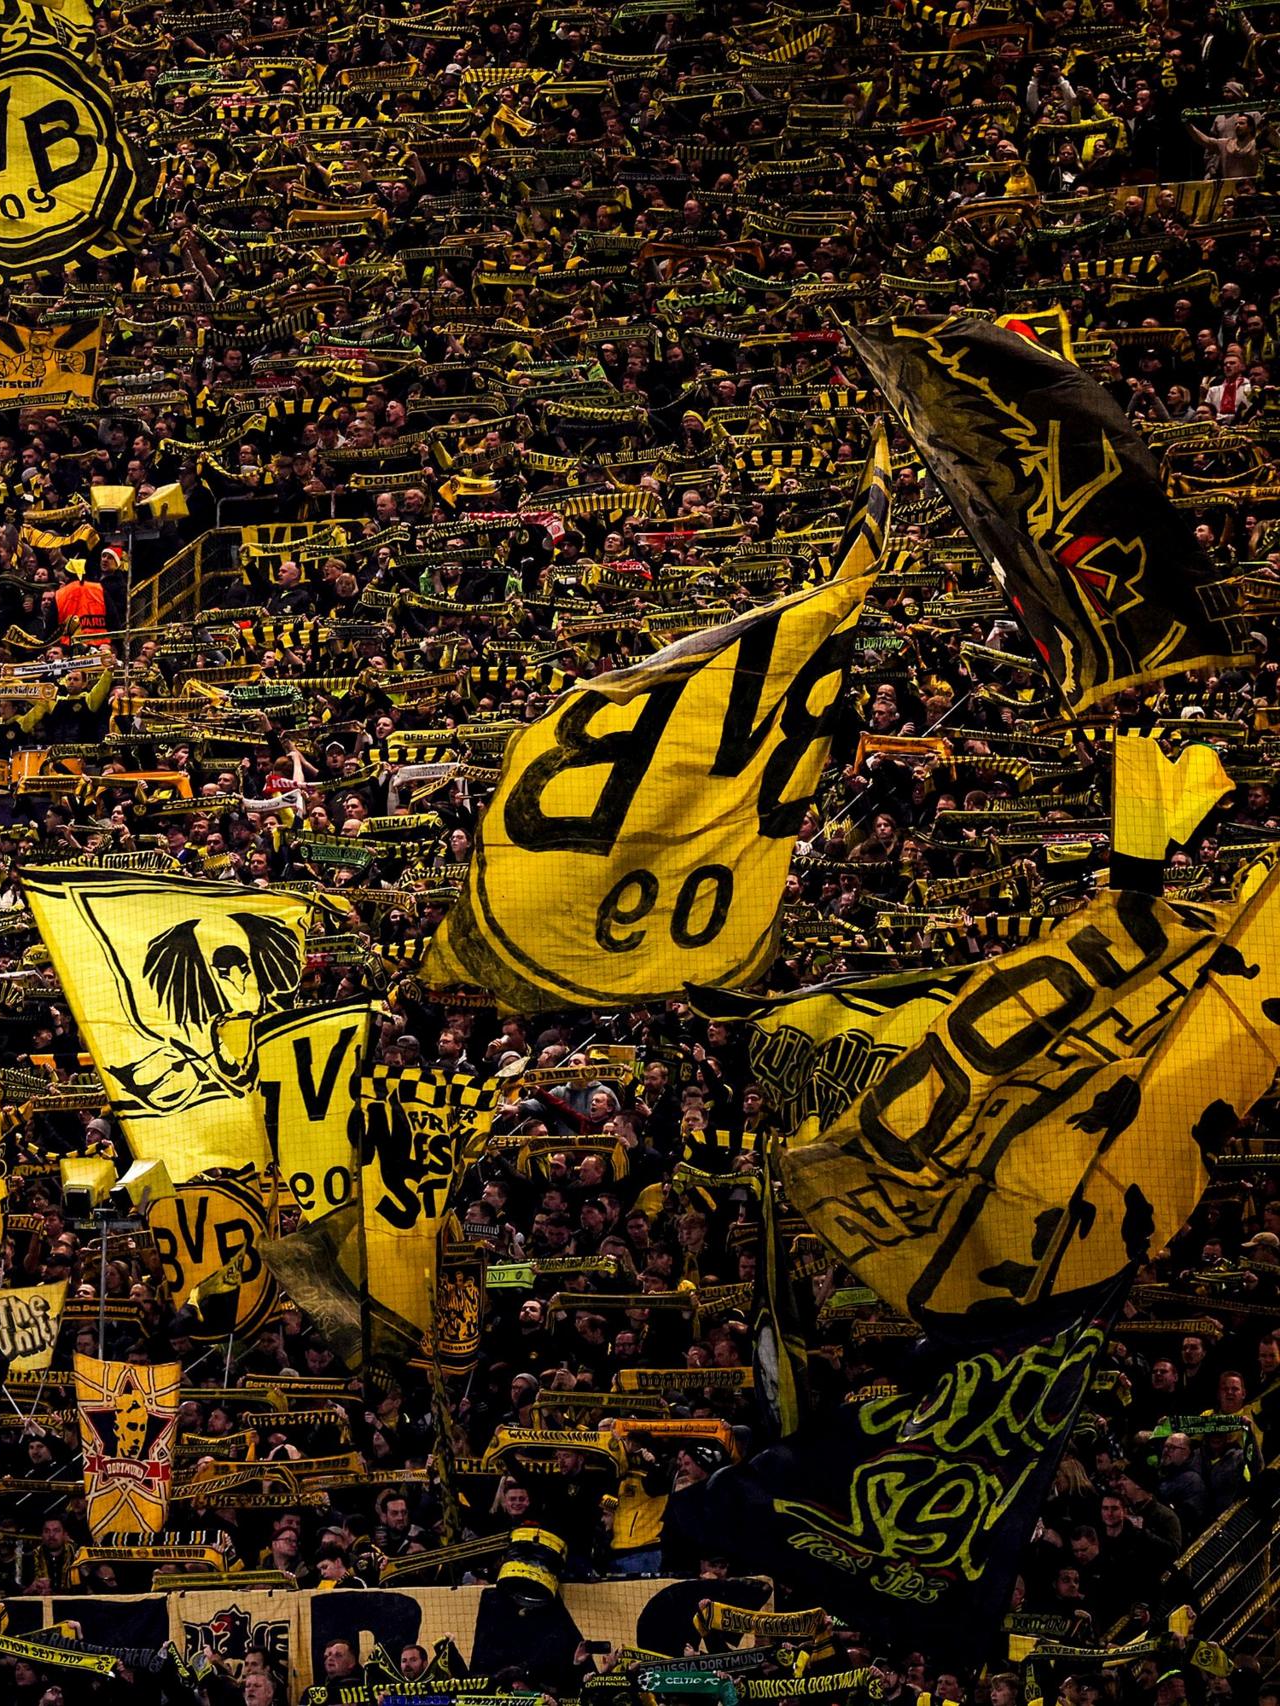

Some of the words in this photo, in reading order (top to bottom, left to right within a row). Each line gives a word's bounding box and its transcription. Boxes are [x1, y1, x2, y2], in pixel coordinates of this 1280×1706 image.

[0, 187, 58, 222] 09
[657, 290, 736, 310] BORUSSIA
[23, 394, 67, 406] DORTMUND
[115, 391, 182, 405] ORTMUND
[364, 472, 427, 486] DORTMU
[691, 609, 733, 626] DORTMUN
[403, 734, 456, 745] DFB-POKA
[376, 816, 414, 830] HEIMAT
[51, 854, 101, 869] RUSSIA
[105, 851, 171, 869] DORTMUND
[797, 925, 838, 937] BORUSSI
[428, 994, 496, 1008] DORTMUN
[539, 1070, 579, 1081] JAHRE
[154, 1196, 262, 1292] BVB
[152, 1547, 206, 1558] DORTMUND
[31, 1646, 56, 1661] SEIT
[58, 1651, 83, 1665] 1909
[699, 1651, 765, 1673] DORTMUND
[665, 1676, 699, 1686] CELTIC
[703, 1676, 719, 1685] FC
[747, 1675, 807, 1700] BORUSSIA
[808, 1665, 871, 1695] DORTMUND
[339, 1685, 369, 1704] DIE
